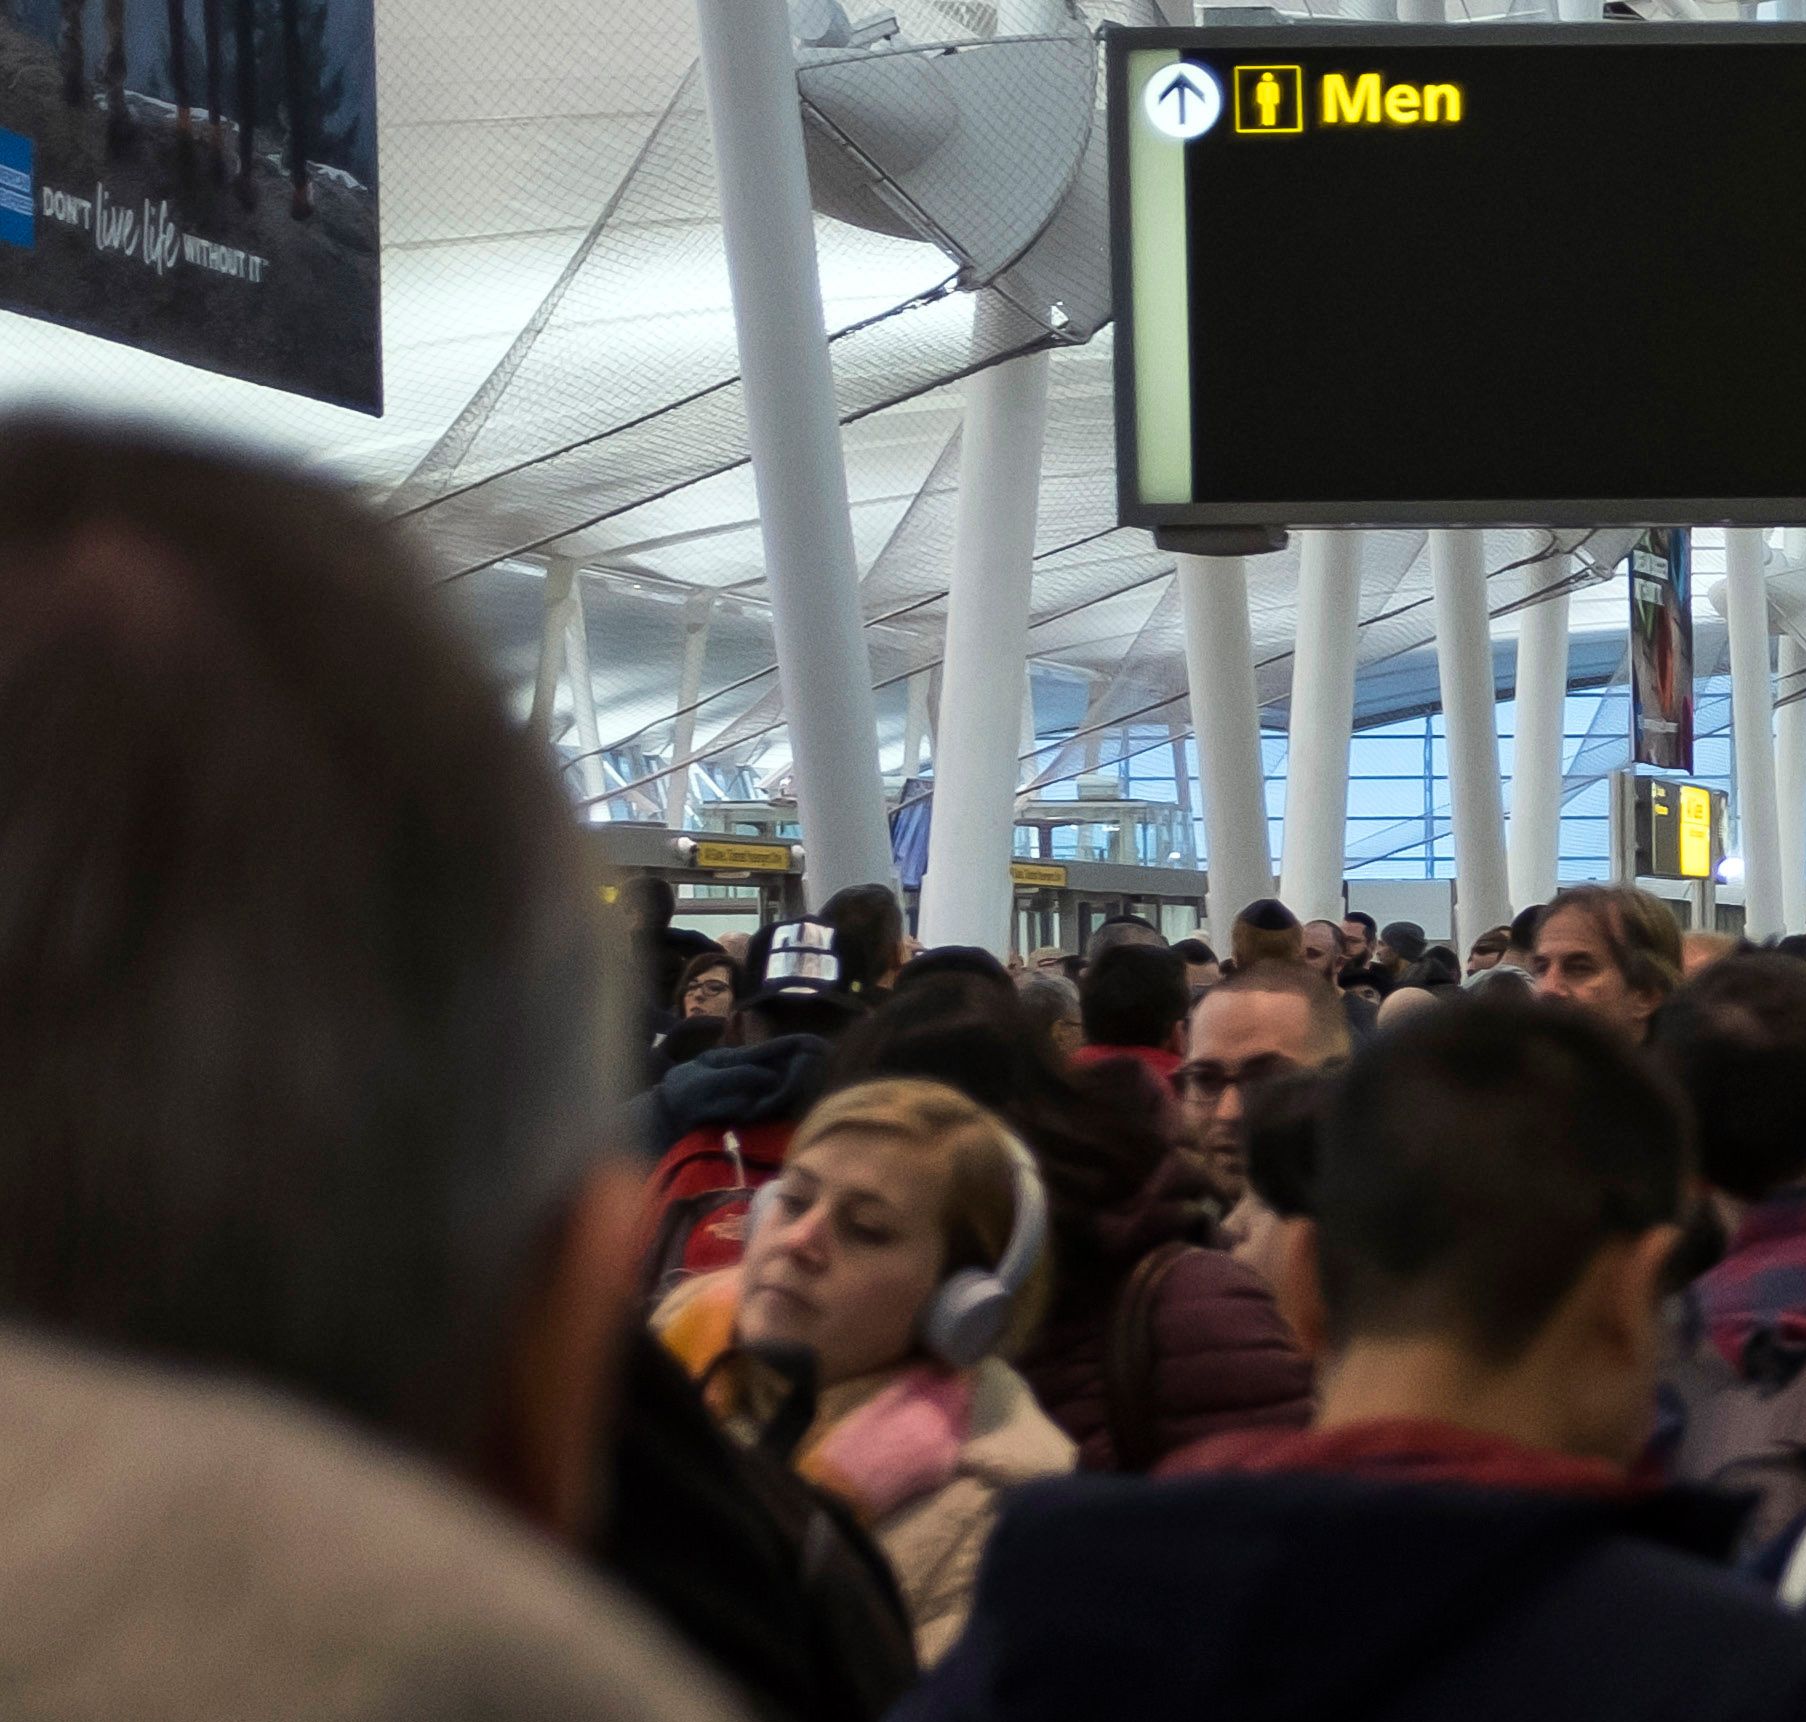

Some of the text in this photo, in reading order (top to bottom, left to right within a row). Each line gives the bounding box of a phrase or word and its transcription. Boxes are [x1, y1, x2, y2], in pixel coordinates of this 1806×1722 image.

[1321, 73, 1462, 125] Men
[96, 181, 141, 256] live
[142, 198, 181, 276] life
[182, 233, 245, 279] WITHOUT
